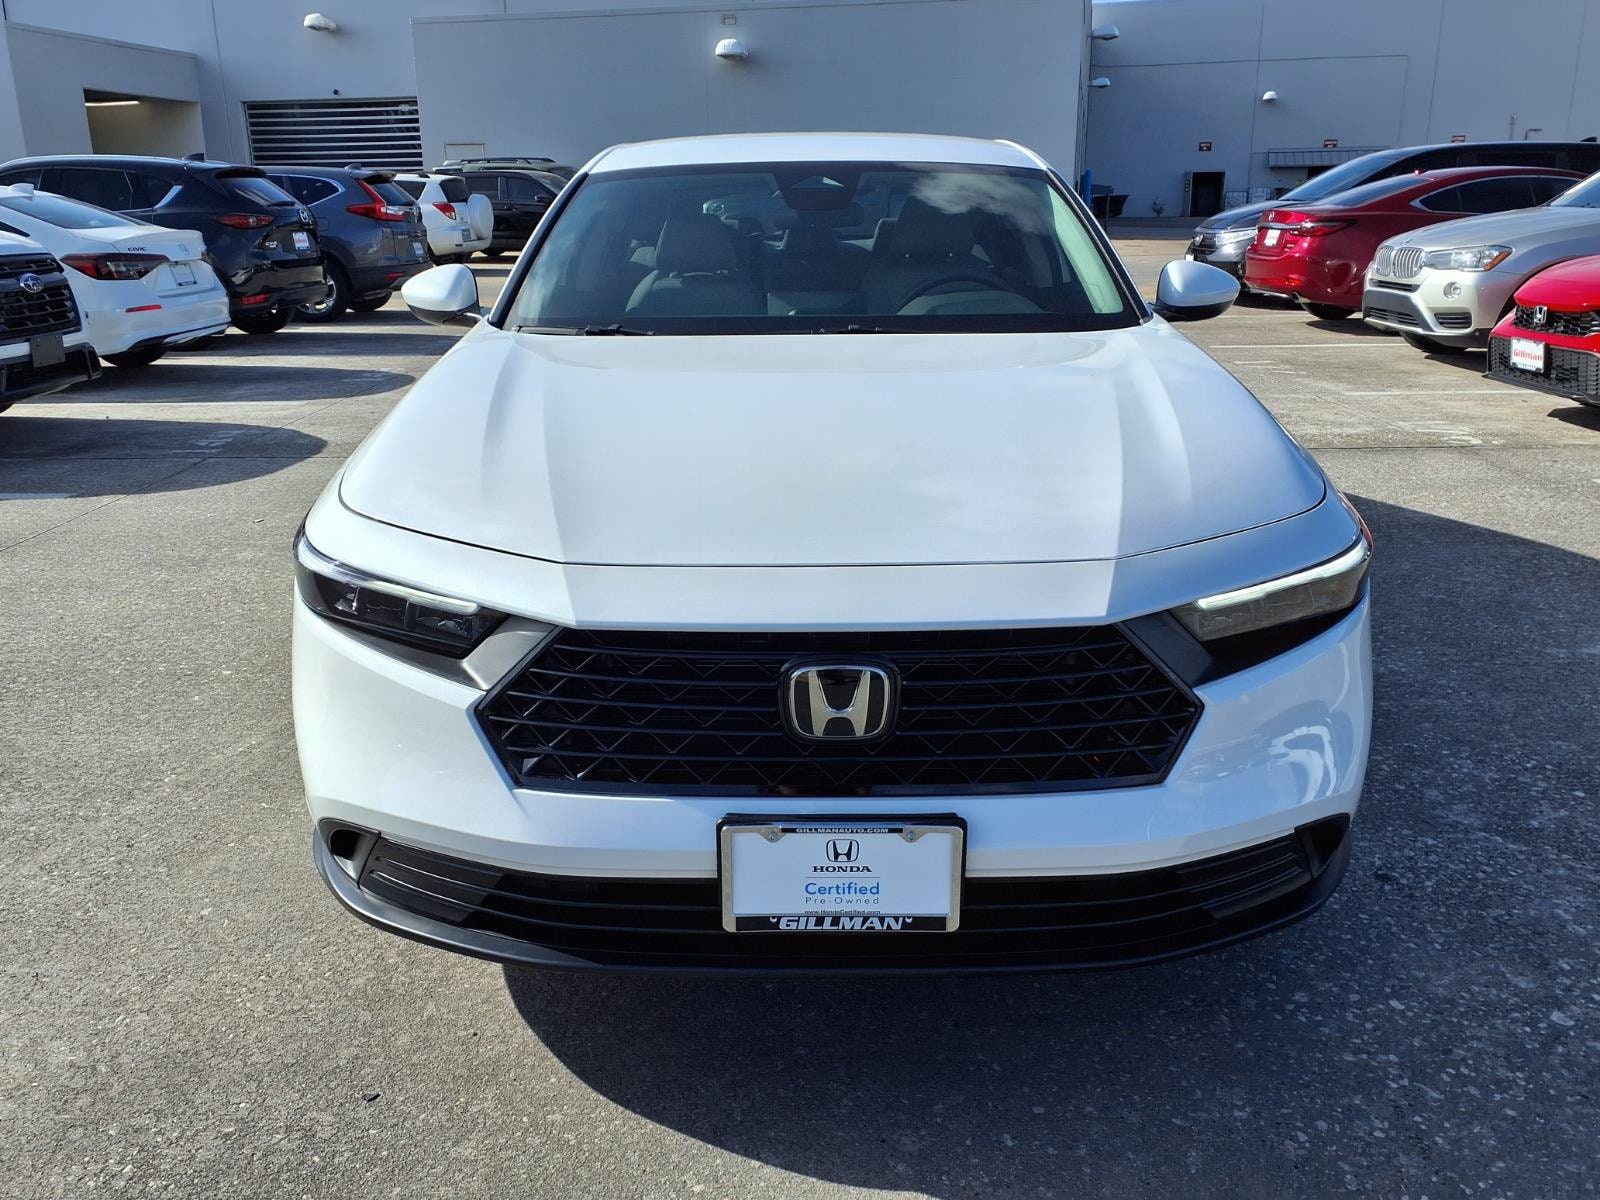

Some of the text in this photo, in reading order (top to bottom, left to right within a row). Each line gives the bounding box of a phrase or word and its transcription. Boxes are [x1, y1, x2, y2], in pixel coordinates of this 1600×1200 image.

[1513, 349, 1543, 361] Gillman
[812, 865, 872, 873] HONDA
[804, 882, 880, 895] Certified
[805, 897, 879, 905] Pre-Owned
[779, 916, 903, 930] GILLMAN
